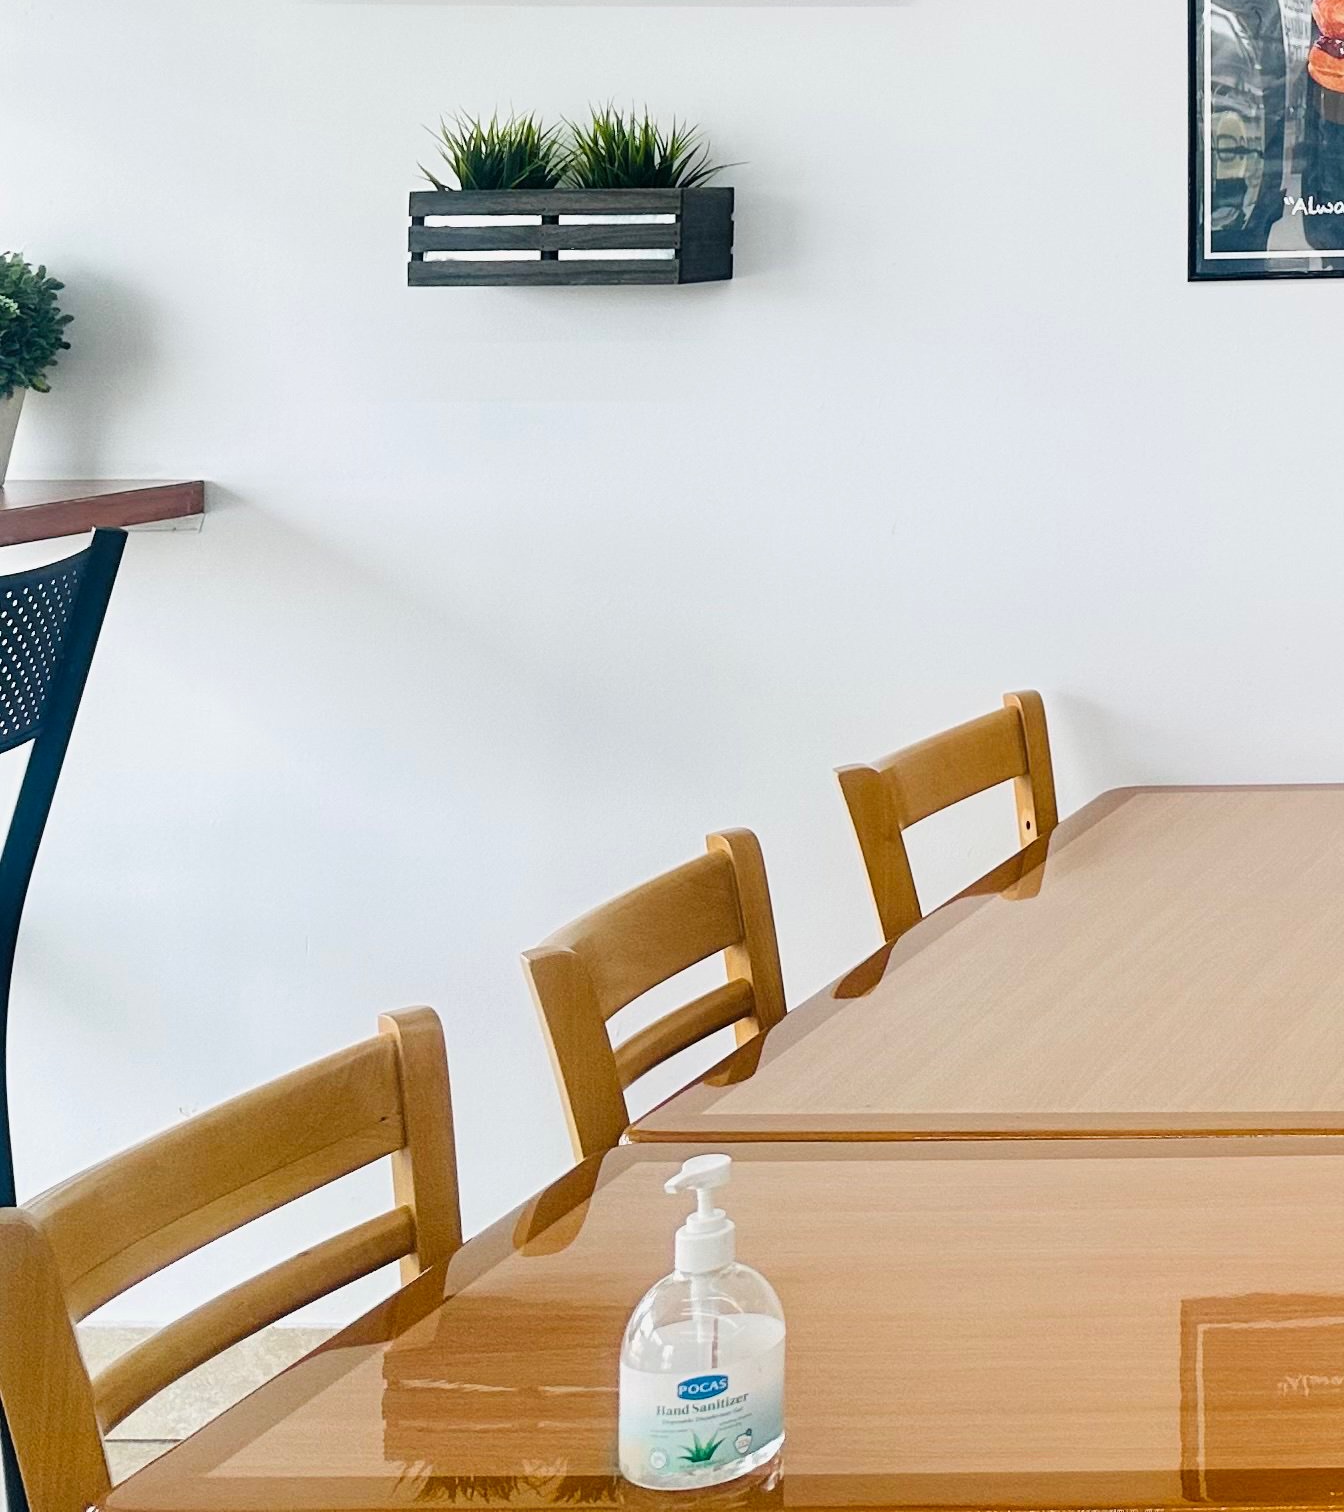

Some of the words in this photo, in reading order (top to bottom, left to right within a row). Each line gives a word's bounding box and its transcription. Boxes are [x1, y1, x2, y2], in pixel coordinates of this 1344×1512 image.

[679, 1378, 727, 1396] POCAS
[656, 1404, 689, 1416] Hand
[692, 1393, 749, 1414] Sanitizer
